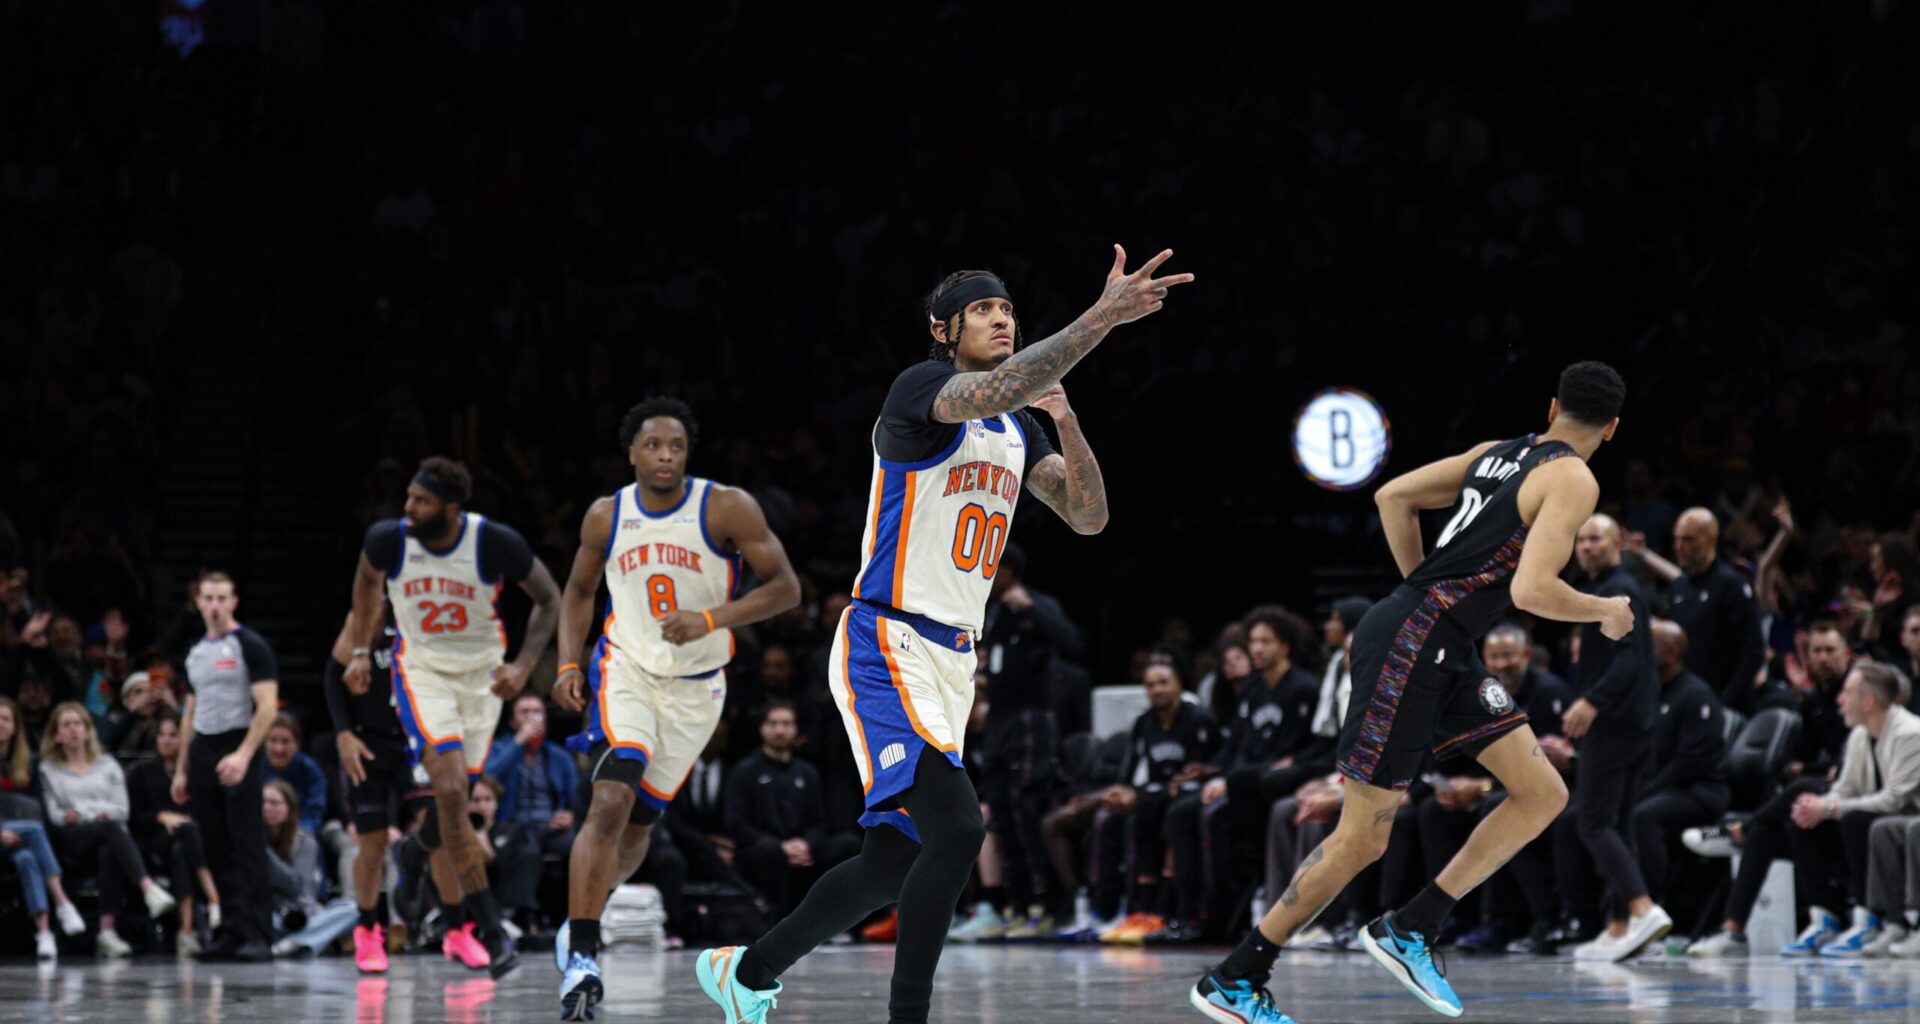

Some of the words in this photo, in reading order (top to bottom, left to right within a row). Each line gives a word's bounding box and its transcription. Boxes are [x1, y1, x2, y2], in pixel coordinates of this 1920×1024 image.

[1329, 408, 1356, 469] B
[943, 461, 992, 497] NEW
[990, 466, 1019, 511] YOR
[618, 543, 649, 575] NEW
[655, 543, 703, 574] YORK
[951, 502, 1008, 581] 00
[404, 578, 432, 598] NEW
[437, 578, 475, 600] YORK
[646, 574, 677, 619] 8
[418, 601, 468, 633] 23
